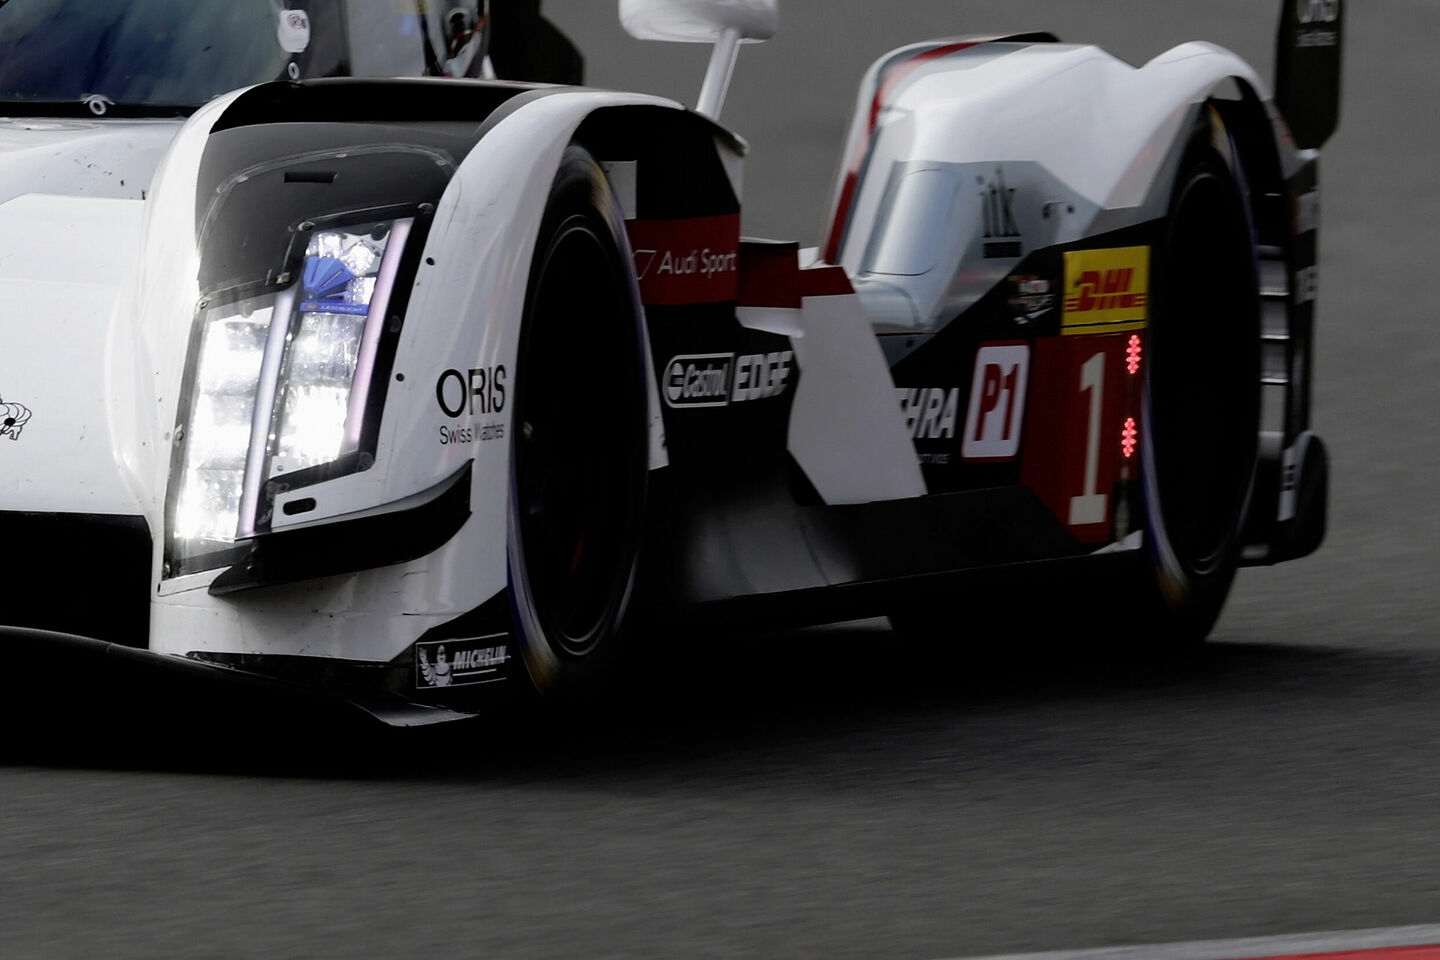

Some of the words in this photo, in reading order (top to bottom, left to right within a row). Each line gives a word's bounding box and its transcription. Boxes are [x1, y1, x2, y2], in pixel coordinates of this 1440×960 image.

[657, 249, 697, 274] Audi
[700, 247, 737, 279] Sport
[1077, 267, 1135, 311] DHL
[436, 364, 506, 418] ORIS
[683, 363, 728, 398] Castrol
[731, 350, 792, 401] EDGE
[973, 363, 1021, 441] P1
[439, 418, 472, 445] Swiss
[1068, 351, 1108, 526] 1
[452, 644, 508, 671] MICHELIN
